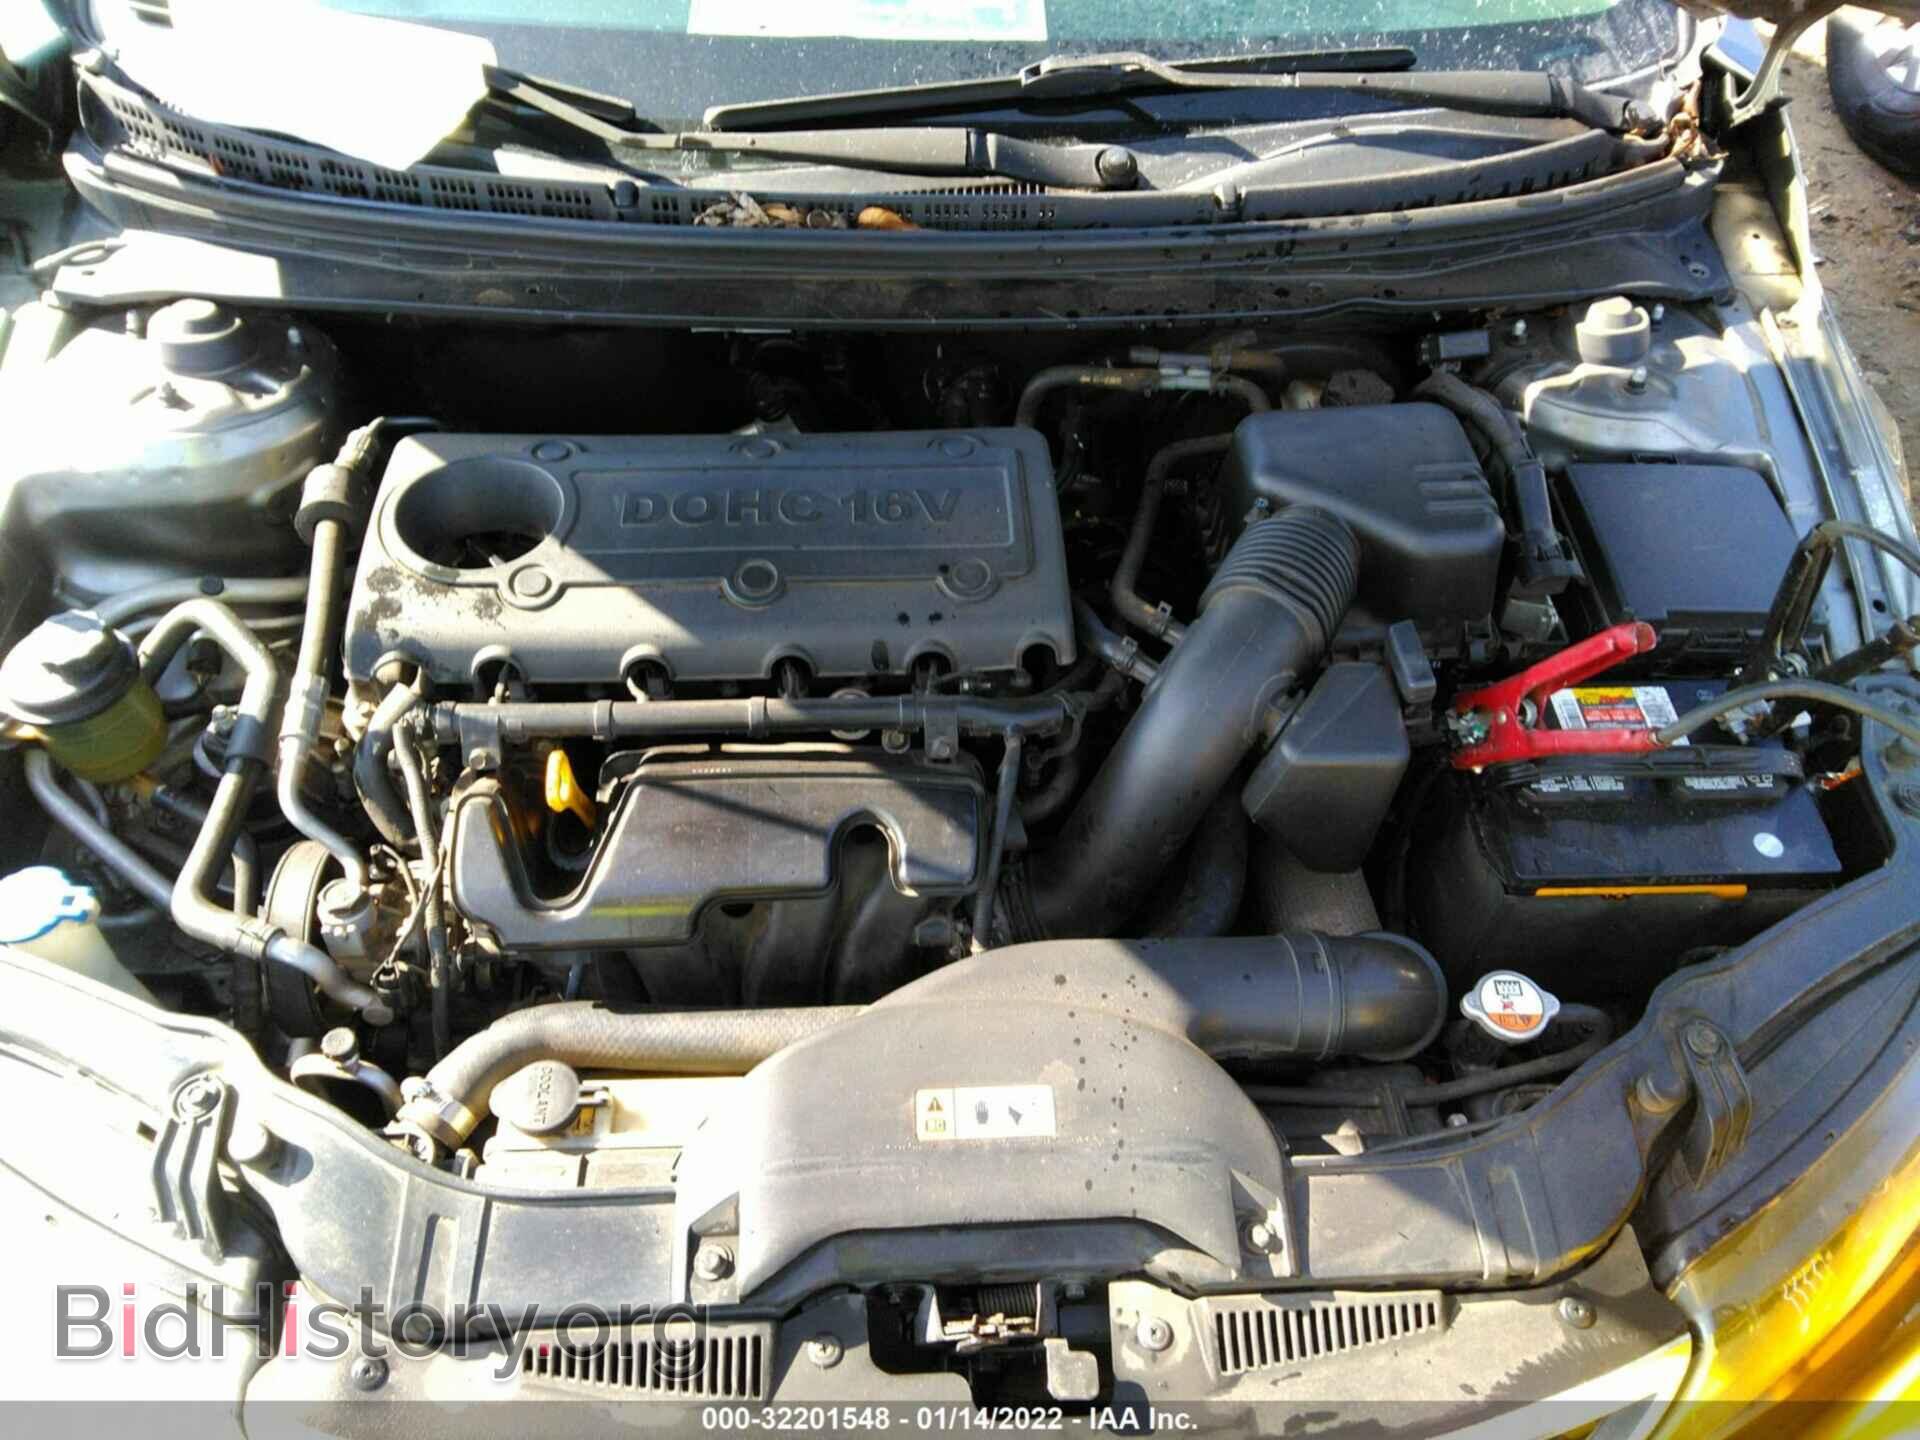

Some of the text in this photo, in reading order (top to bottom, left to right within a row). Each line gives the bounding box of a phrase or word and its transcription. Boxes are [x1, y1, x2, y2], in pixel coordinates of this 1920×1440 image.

[617, 488, 963, 528] DOHC 16V
[534, 1066, 553, 1125] COOLANT
